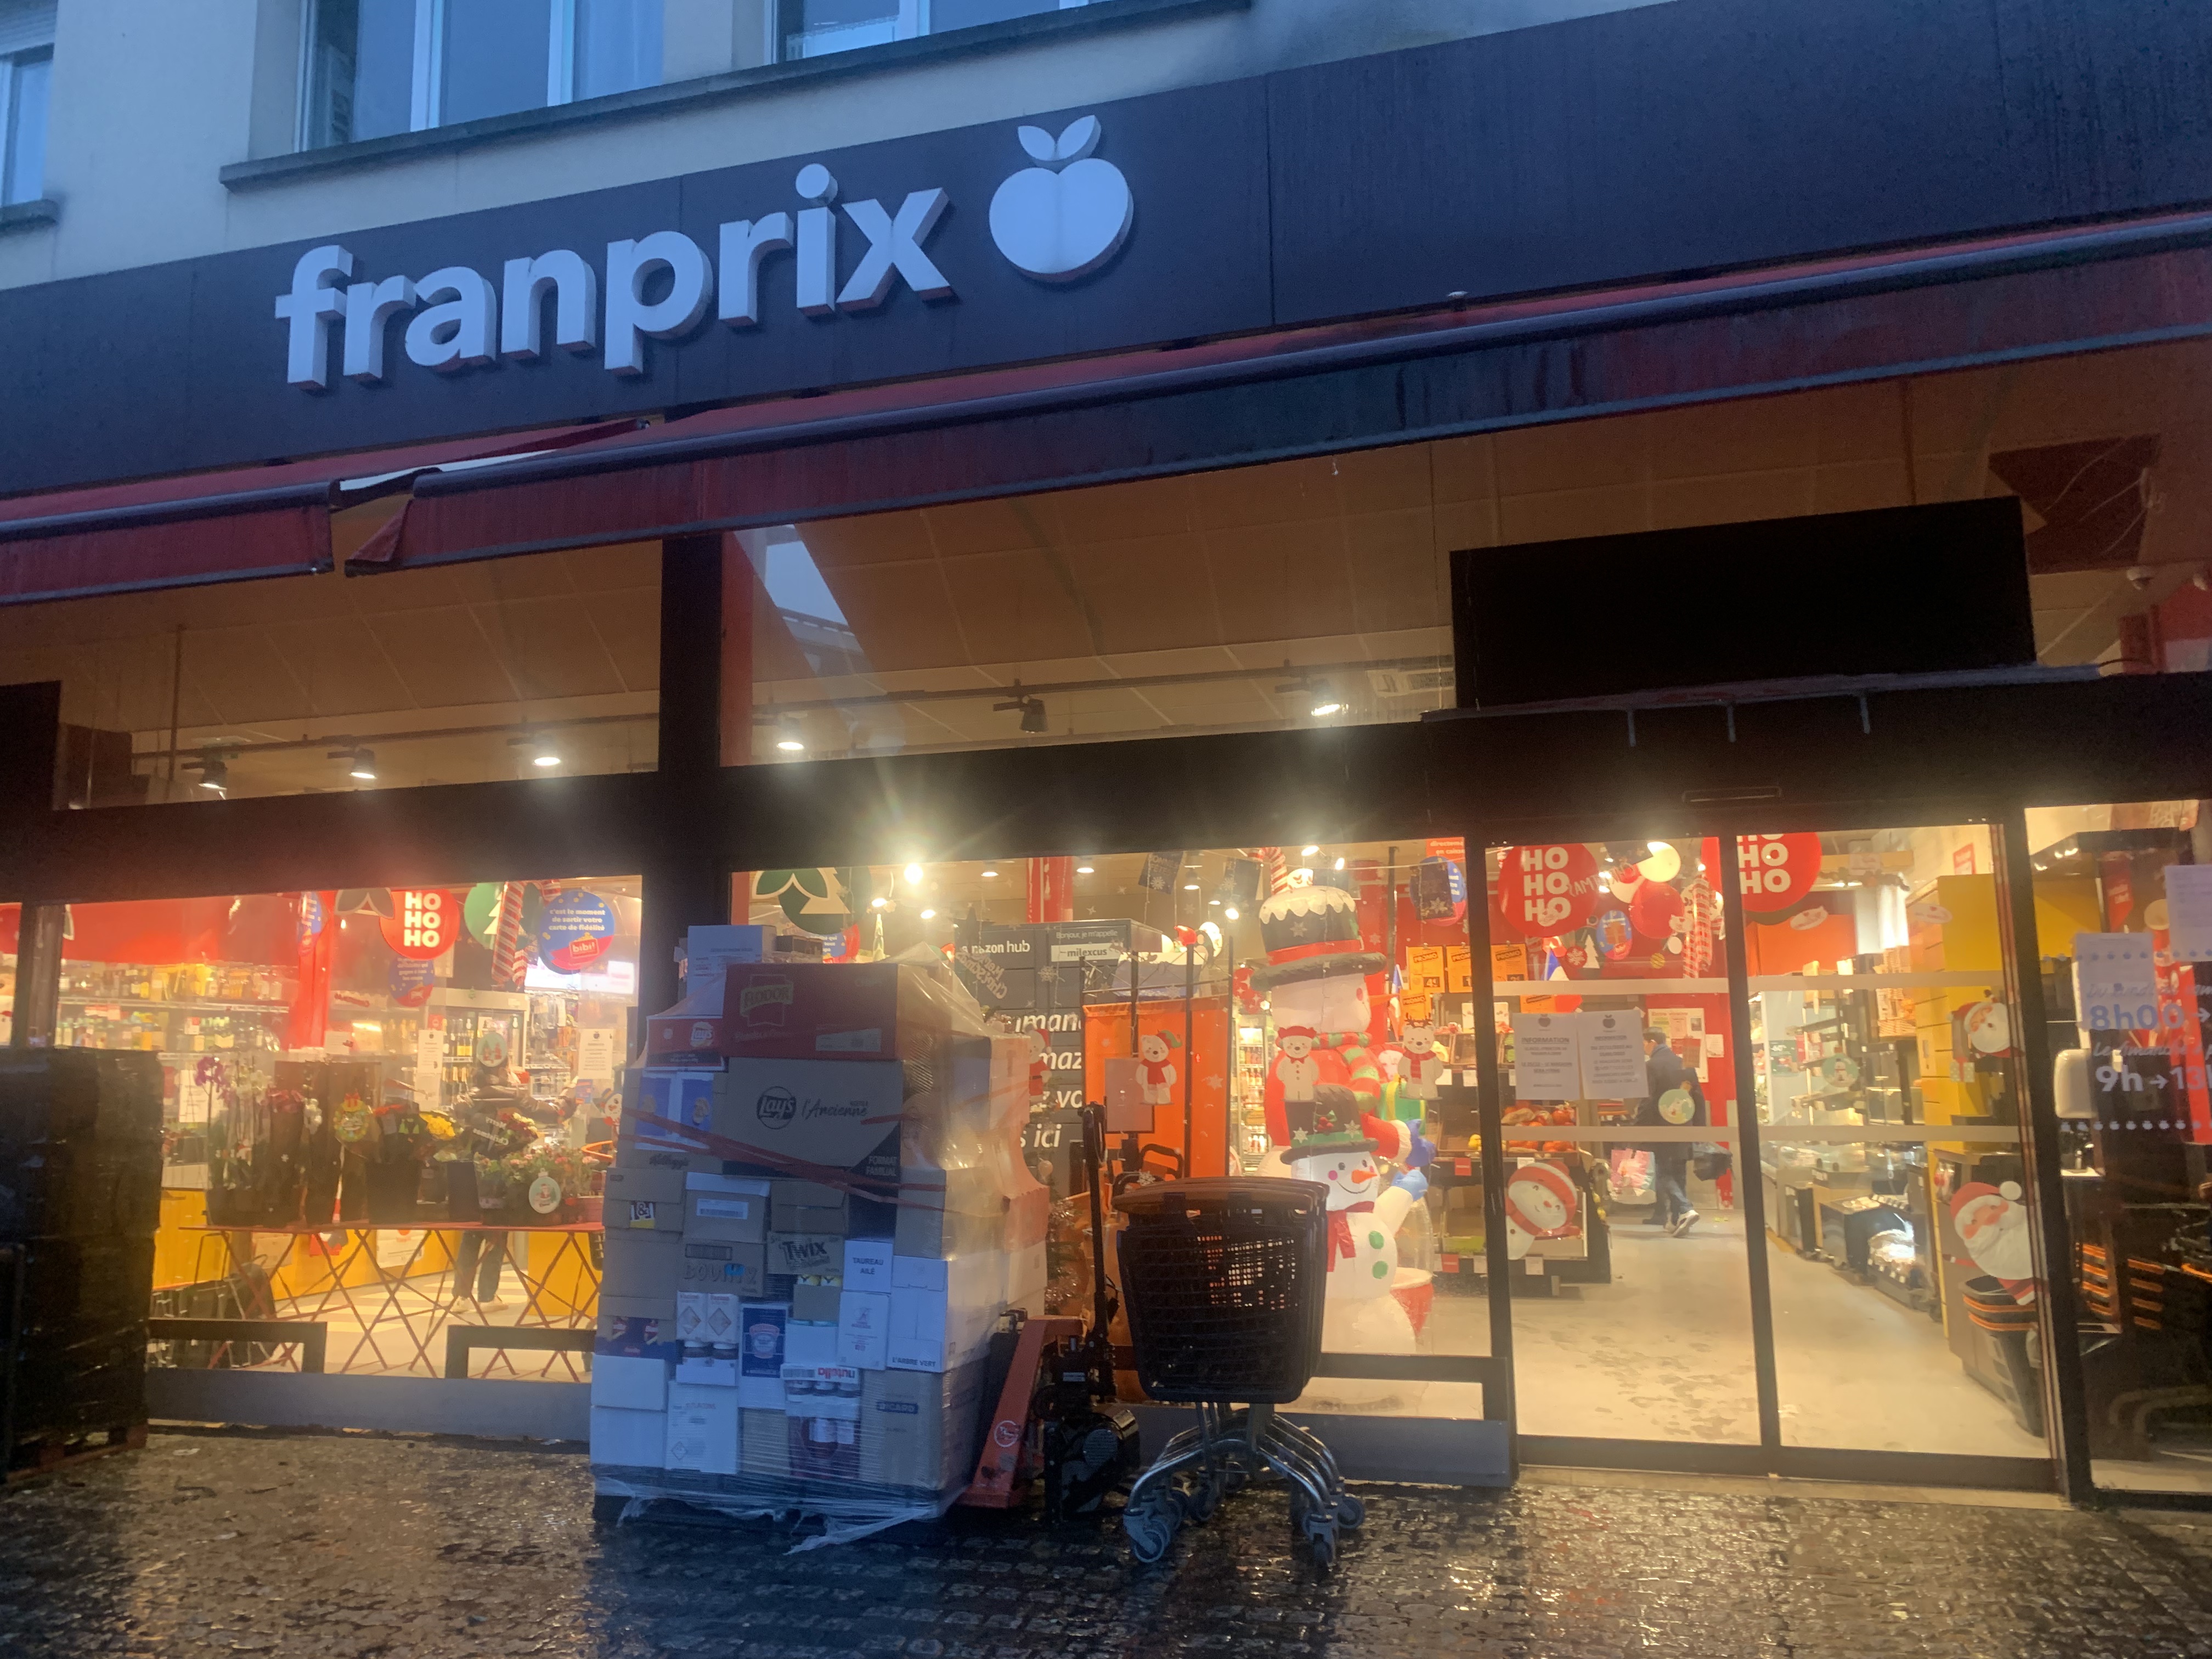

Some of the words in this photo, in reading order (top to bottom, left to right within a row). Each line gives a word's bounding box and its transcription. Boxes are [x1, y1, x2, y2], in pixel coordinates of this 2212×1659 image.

[274, 163, 953, 388] franprix
[1523, 847, 1568, 872] HO
[1737, 842, 1788, 868] HO
[1523, 871, 1570, 896] HO
[1740, 868, 1792, 894] HO
[404, 891, 441, 911] HO
[1524, 896, 1572, 922] HO
[404, 910, 441, 929] HO
[403, 929, 440, 948] HO
[1088, 929, 1118, 938] m'appelle
[572, 941, 595, 953] bibi!
[1006, 939, 1030, 953] hub
[1066, 947, 1108, 958] milexcus
[1414, 952, 1438, 962] PROMO
[1453, 952, 1471, 961] PROM
[1496, 949, 1521, 960] PROMO
[1403, 995, 1425, 1005] PROMO
[2090, 1003, 2185, 1031] 8h00
[2093, 1041, 2111, 1057] Le
[2095, 1064, 2143, 1092] 9h
[758, 1096, 795, 1120] Lay's
[1034, 1124, 1062, 1148] ici
[867, 1156, 898, 1165] FORMAT
[866, 1166, 897, 1176] FAMILIAL
[853, 1257, 884, 1266] TAUREAU
[892, 1357, 918, 1365] L'ARBRE
[817, 1367, 855, 1379] nutella
